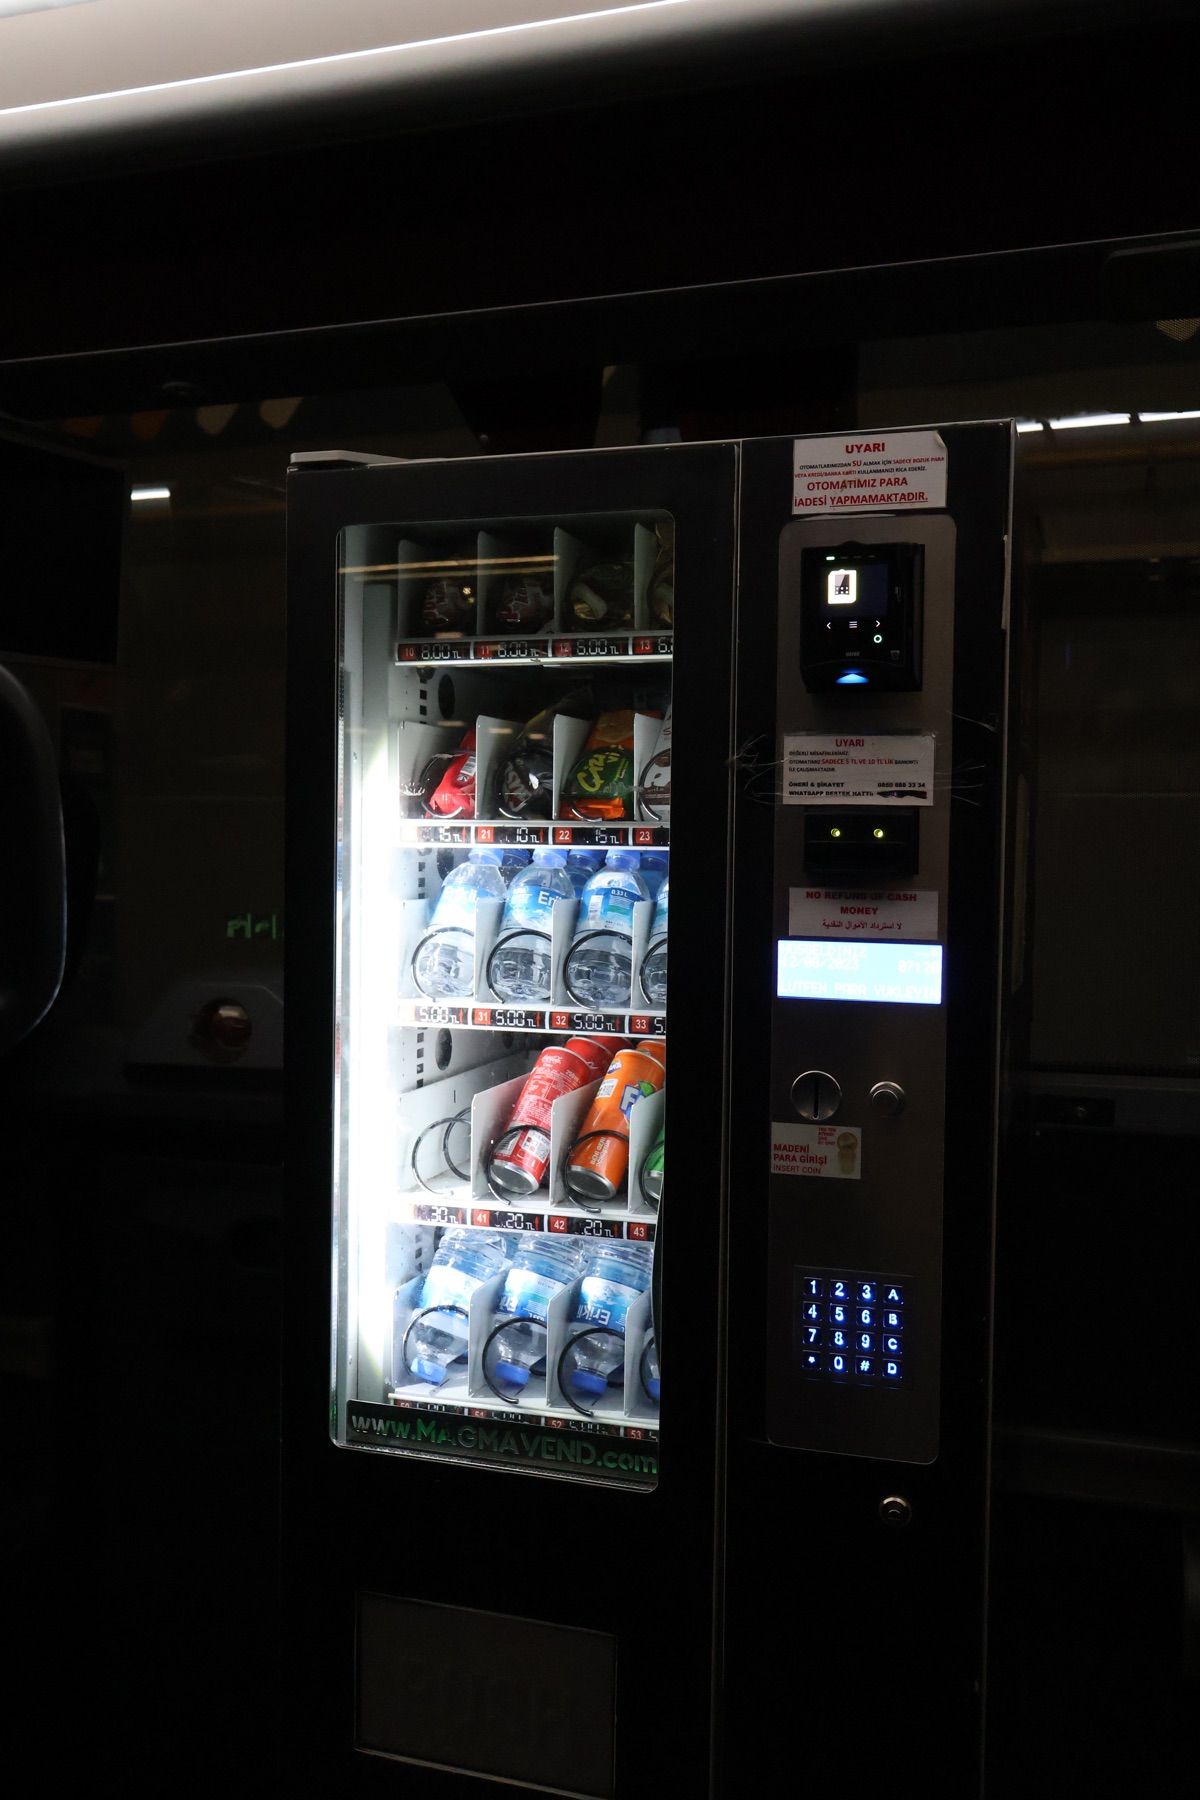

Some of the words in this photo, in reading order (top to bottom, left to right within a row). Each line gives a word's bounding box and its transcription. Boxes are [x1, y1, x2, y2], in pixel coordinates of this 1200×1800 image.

[845, 442, 886, 454] UYARI
[879, 477, 908, 487] PARA
[794, 496, 827, 507] İADESİ
[559, 642, 569, 653] 12
[610, 646, 619, 654] TL
[640, 639, 650, 650] 13
[405, 647, 415, 657] 10
[481, 646, 490, 655] 11
[835, 739, 864, 747] UYARI
[481, 829, 491, 840] 21
[559, 830, 570, 840] 22
[610, 835, 619, 844] TL
[639, 831, 650, 841] 23
[806, 891, 822, 899] NO
[887, 892, 917, 901] CASH
[840, 906, 879, 915] MONEY
[478, 1011, 488, 1021] 31
[495, 1010, 526, 1027] 5.00
[527, 1018, 537, 1027] TL
[555, 1015, 566, 1025] 32
[573, 1013, 604, 1030] 5.00
[606, 1022, 616, 1031] TL
[635, 1019, 647, 1029] 33
[773, 1143, 810, 1153] MADENİ
[773, 1153, 797, 1162] PARA
[799, 1154, 827, 1165] GİRİŞİ
[476, 1213, 487, 1223] 41
[525, 1222, 535, 1231] TL
[553, 1219, 565, 1230] 42
[604, 1228, 614, 1237] TL
[633, 1227, 645, 1237] 43
[810, 1280, 816, 1294] 1
[834, 1282, 845, 1297] 2
[861, 1284, 872, 1299] 3
[888, 1289, 899, 1300] A
[808, 1304, 817, 1318] 4
[834, 1306, 844, 1320] 5
[861, 1309, 870, 1324] 6
[888, 1313, 898, 1325] B
[808, 1328, 817, 1342] 7
[834, 1331, 844, 1345] 8
[861, 1334, 870, 1348] 9
[887, 1338, 898, 1350] C
[833, 1356, 844, 1370] 0
[860, 1360, 870, 1371] #
[887, 1362, 897, 1374] D
[631, 1430, 642, 1440] 53
